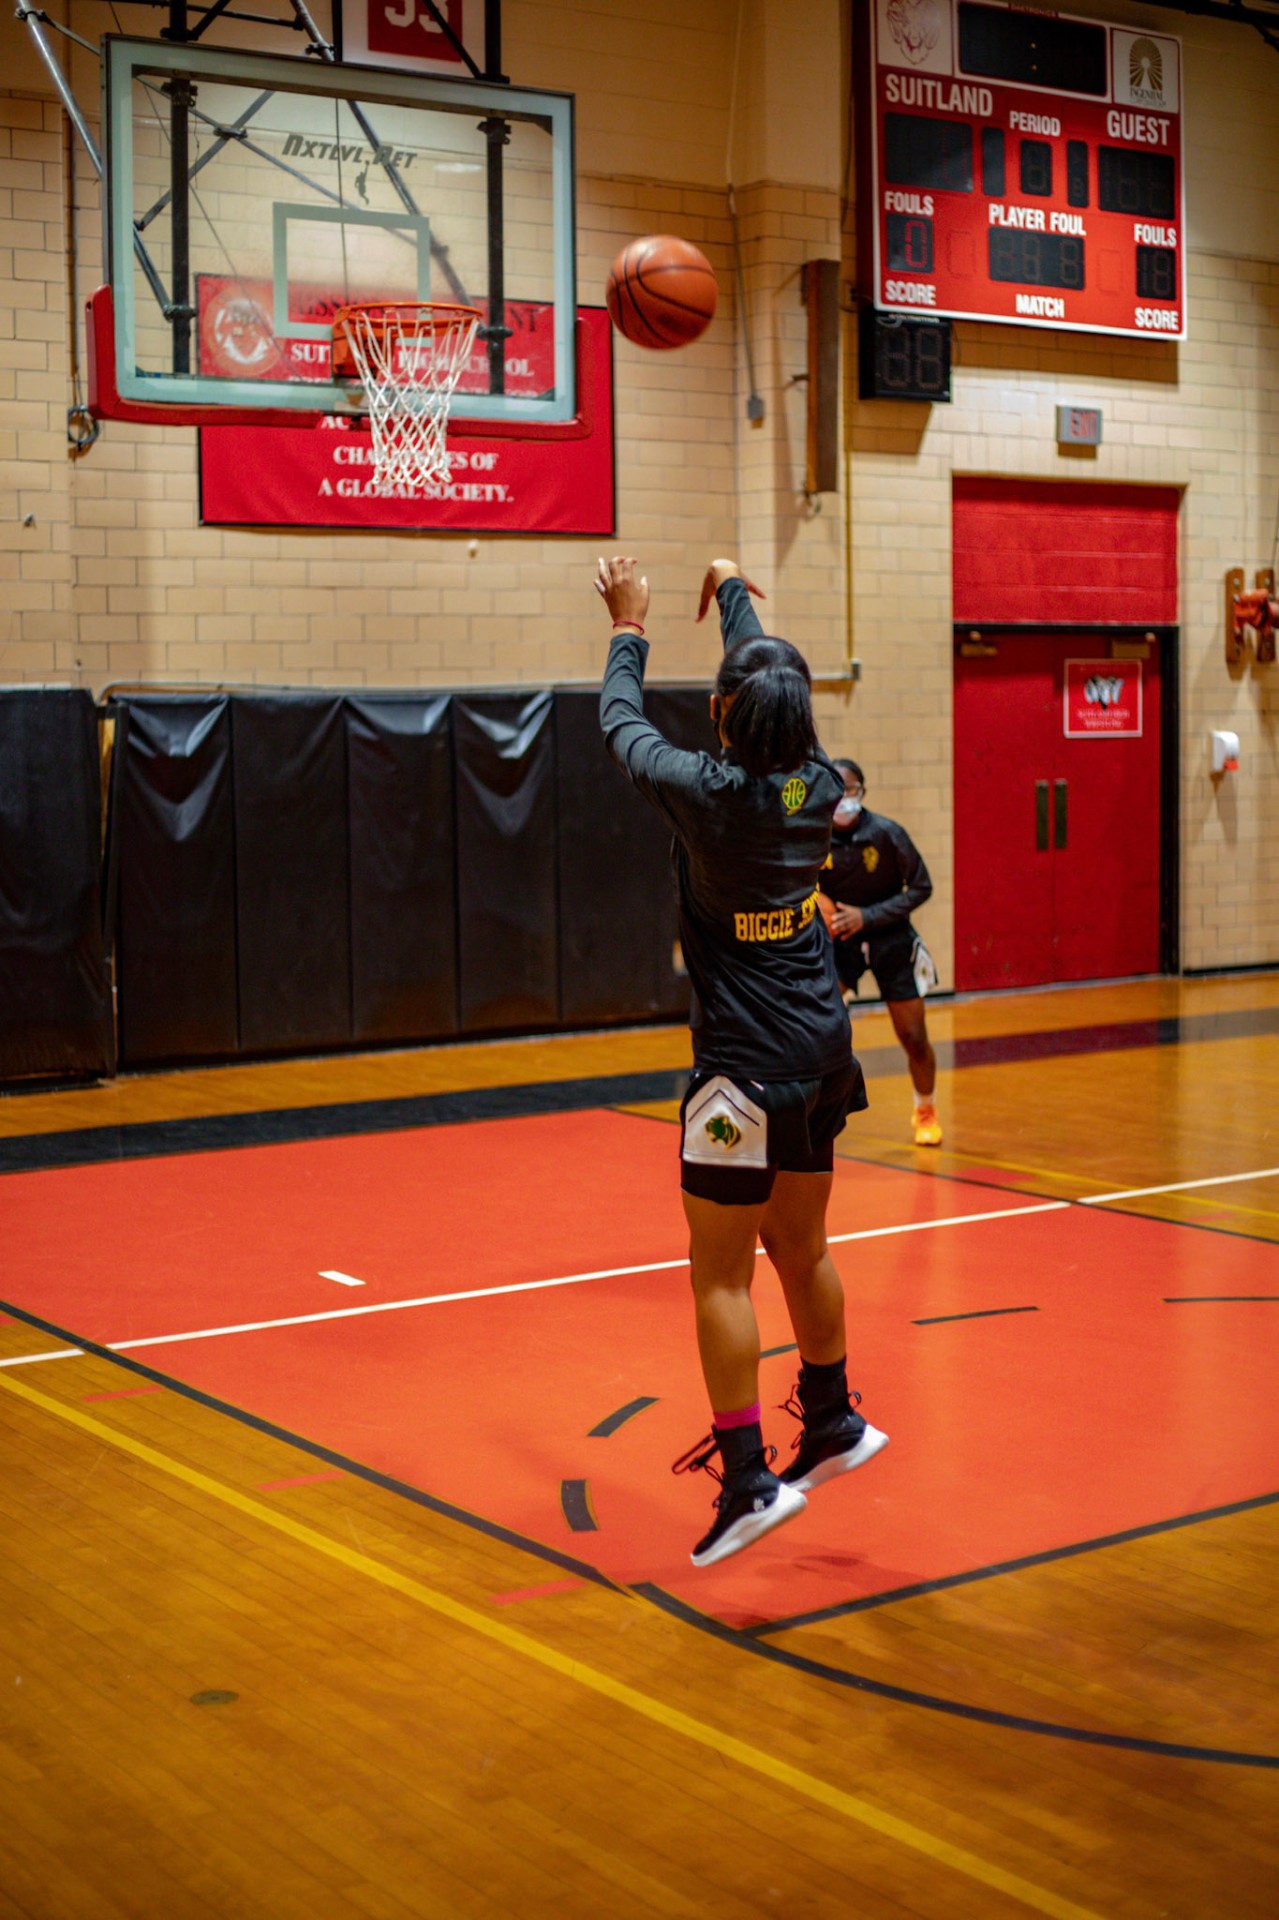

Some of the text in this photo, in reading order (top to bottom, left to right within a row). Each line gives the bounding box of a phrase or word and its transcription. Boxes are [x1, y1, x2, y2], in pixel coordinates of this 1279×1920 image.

[885, 73, 993, 117] SUITLAND
[1009, 110, 1061, 137] PERIOD
[1107, 110, 1170, 146] GUEST
[885, 191, 934, 216] FOULS
[988, 203, 1087, 236] PLAYER FOUL
[1134, 223, 1177, 247] FOULS
[885, 280, 937, 306] SCORE
[1016, 294, 1064, 318] MATCH
[1135, 307, 1179, 331] SCORE
[470, 452, 499, 471] OF
[317, 477, 334, 497] A
[423, 483, 514, 503] SOCIETY.
[734, 909, 794, 942] BIGGIE
